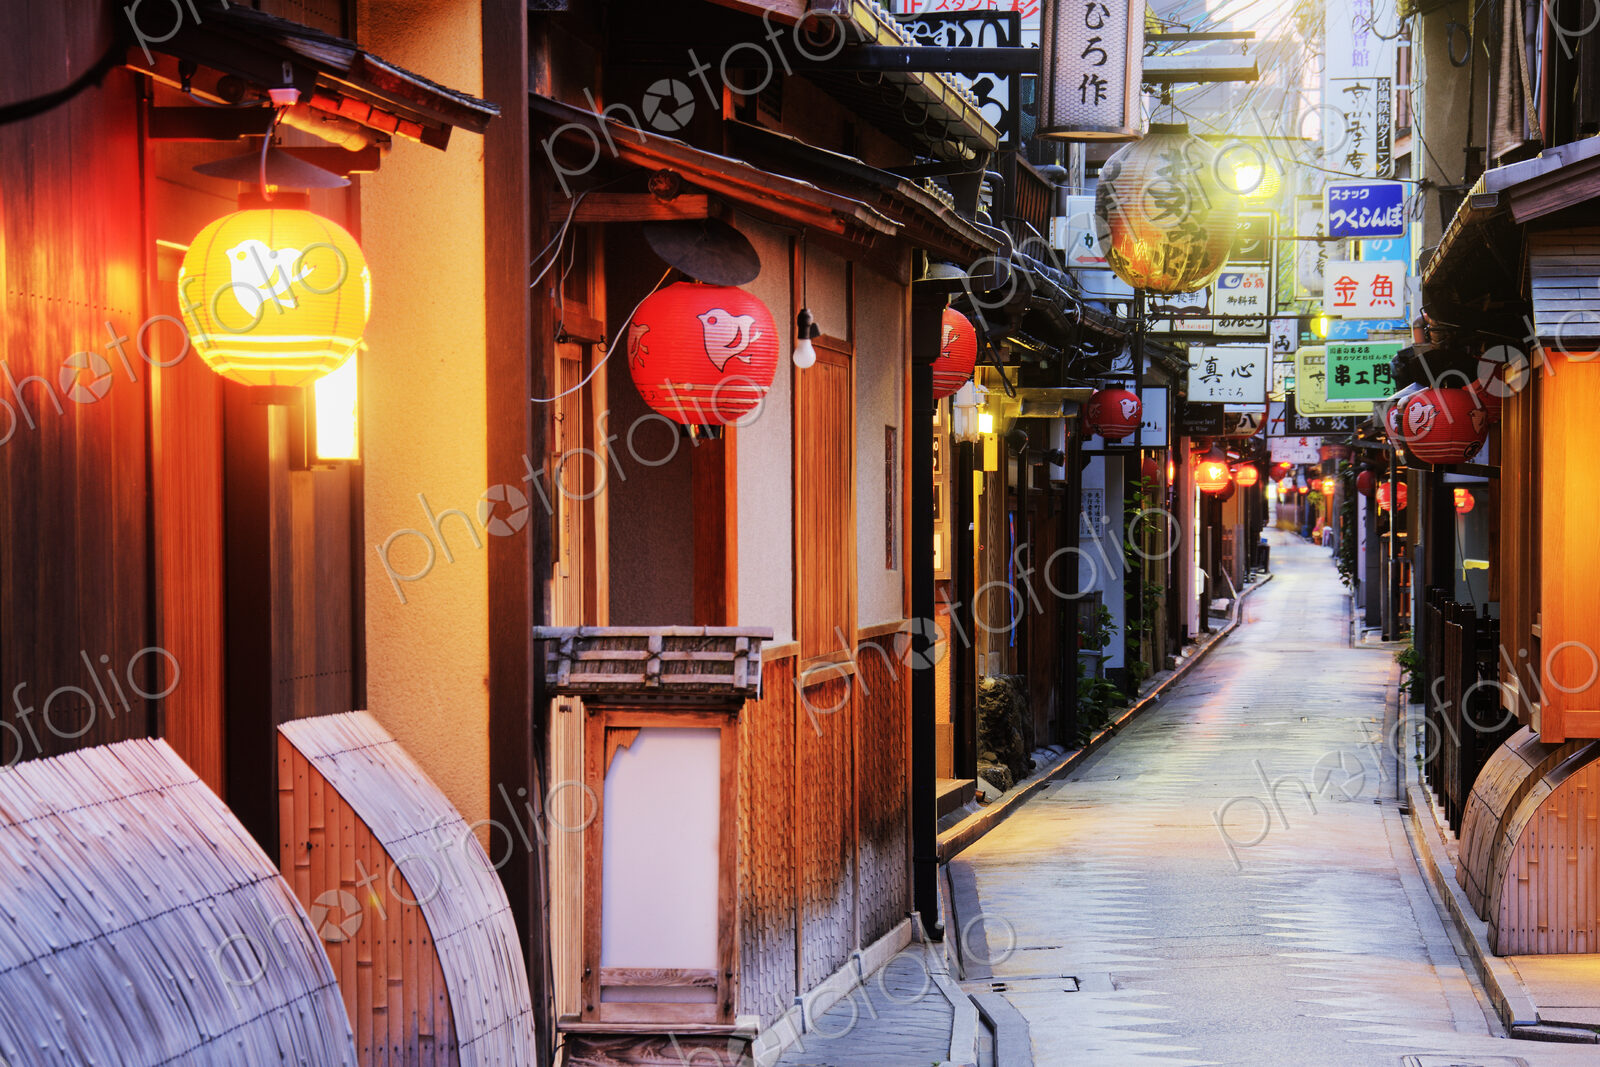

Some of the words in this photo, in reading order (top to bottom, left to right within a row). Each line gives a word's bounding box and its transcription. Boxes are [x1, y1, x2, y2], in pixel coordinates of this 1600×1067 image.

[1078, 1, 1111, 106] ひろ作
[1377, 78, 1391, 178] 京風鉄板ダイニング
[1331, 188, 1370, 201] スナック
[1329, 203, 1404, 229] つくしんぼ
[1333, 274, 1396, 307] 金魚
[1199, 356, 1255, 384] 真心
[1209, 388, 1244, 397] まごころ
